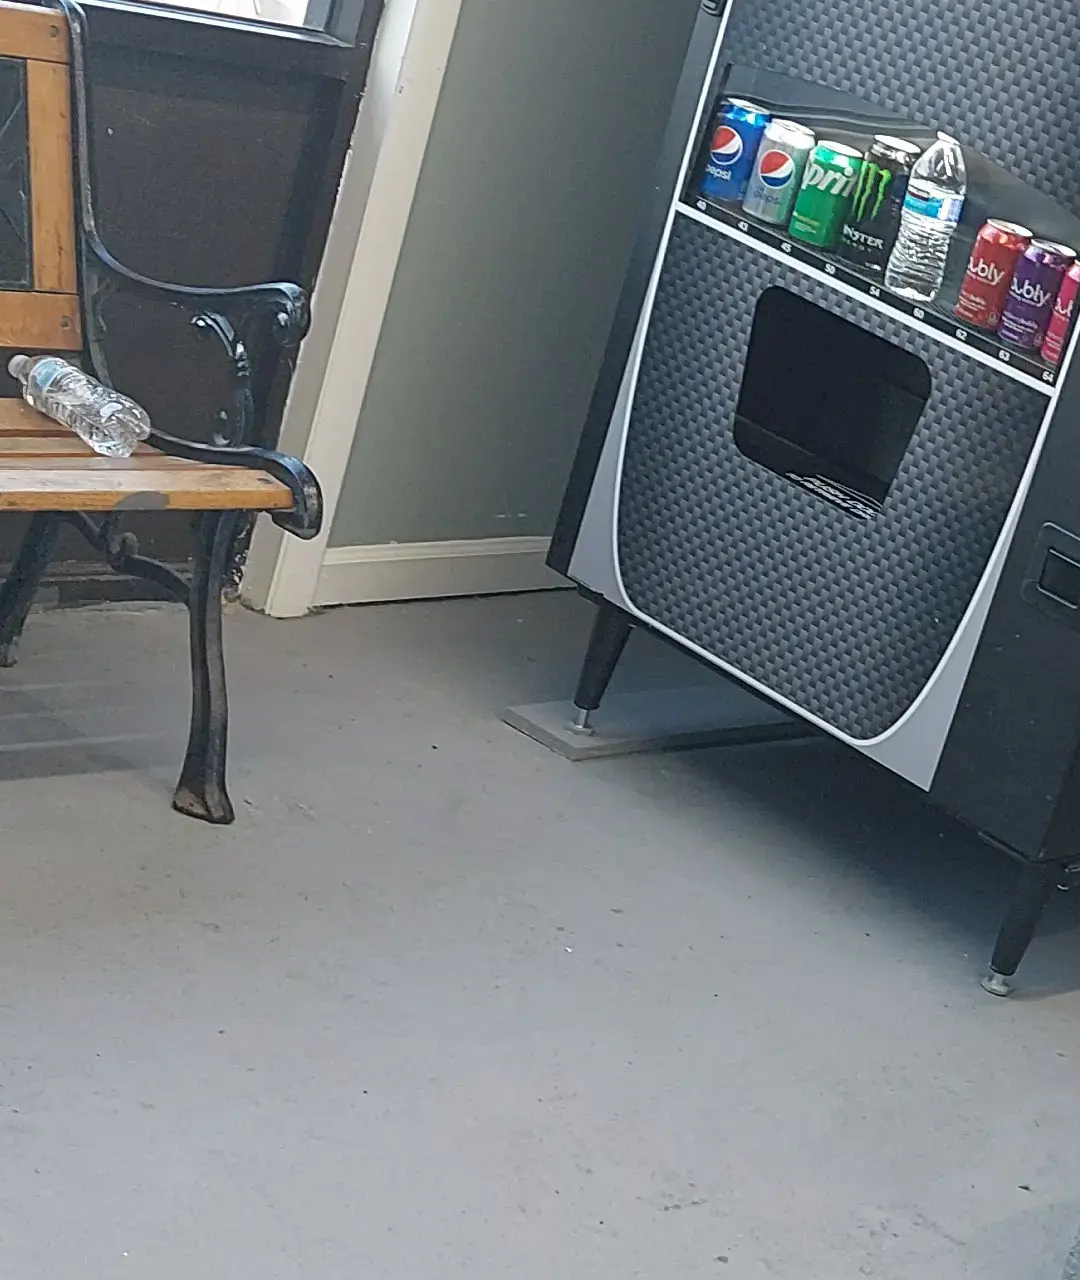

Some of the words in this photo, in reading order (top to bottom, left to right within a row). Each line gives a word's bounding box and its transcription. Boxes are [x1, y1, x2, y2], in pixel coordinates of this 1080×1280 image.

[967, 256, 1005, 286] ubly
[1011, 277, 1051, 308] ubly
[956, 329, 967, 340] 62
[999, 350, 1010, 362] 63
